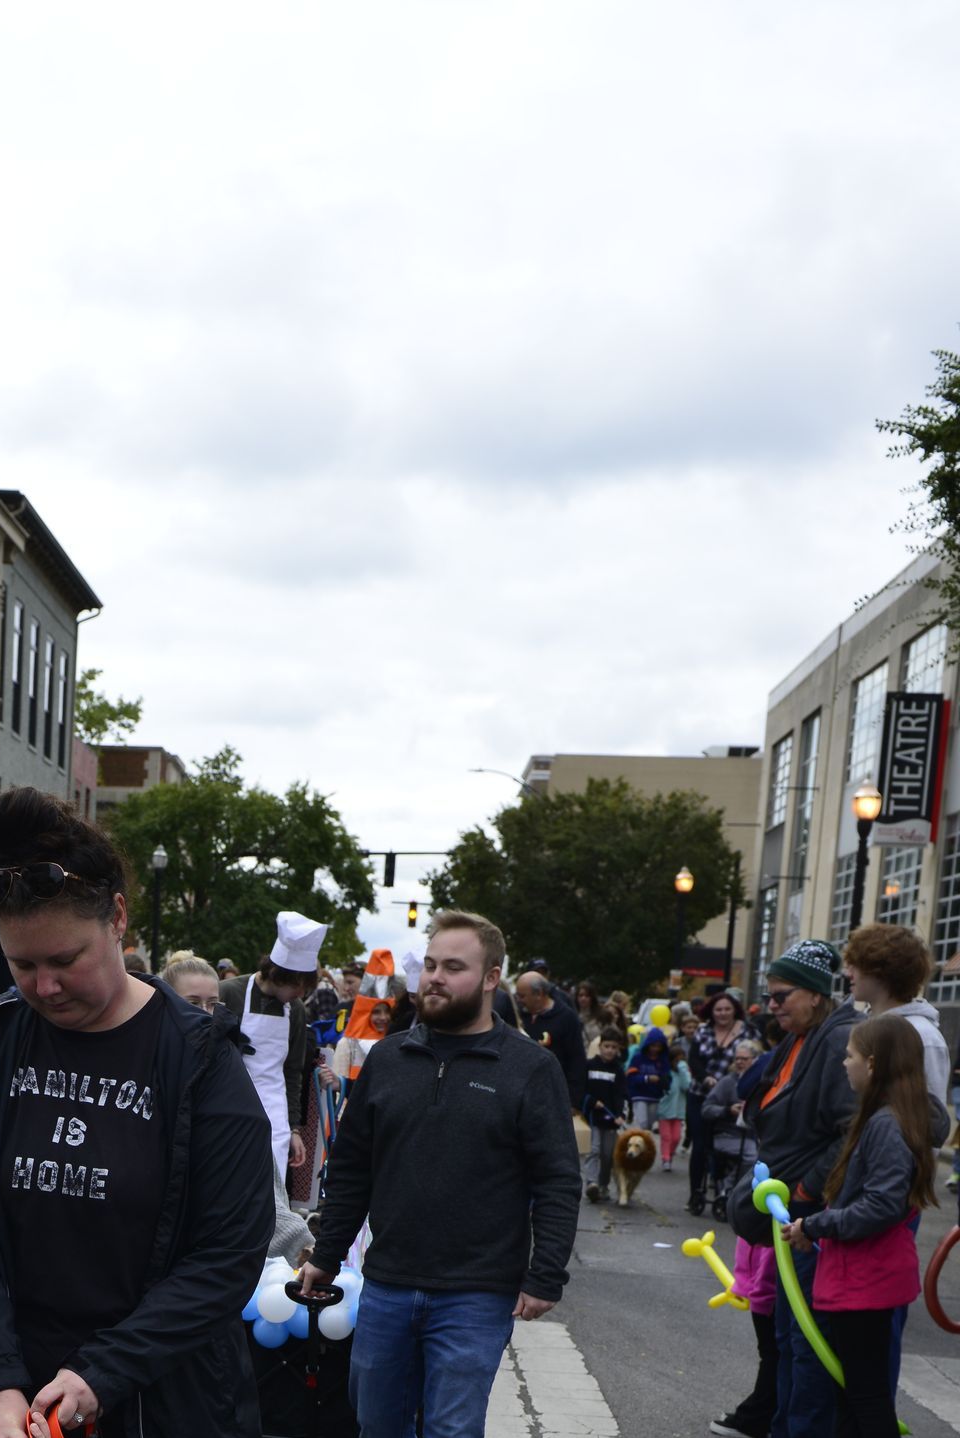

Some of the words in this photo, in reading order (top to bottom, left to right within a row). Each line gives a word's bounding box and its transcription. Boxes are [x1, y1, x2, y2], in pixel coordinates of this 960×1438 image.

[889, 700, 930, 816] THEATRE
[9, 1066, 154, 1121] HAMILTON
[52, 1116, 88, 1147] IS
[11, 1156, 109, 1200] HOME
